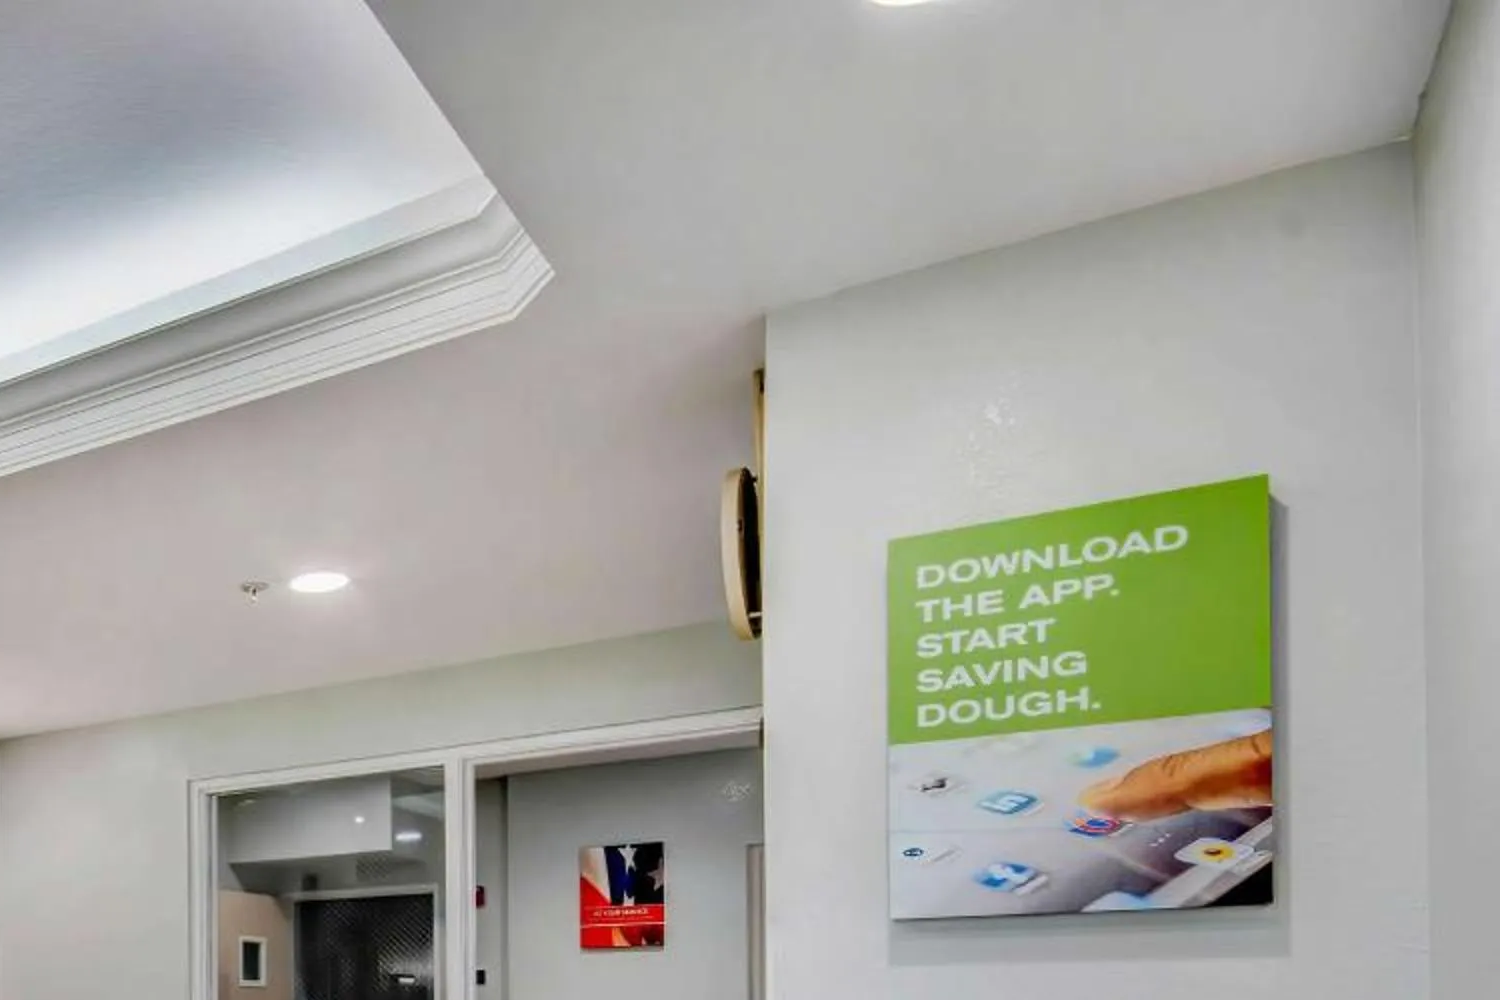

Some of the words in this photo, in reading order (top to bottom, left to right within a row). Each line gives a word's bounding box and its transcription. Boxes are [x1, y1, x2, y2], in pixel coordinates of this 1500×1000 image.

[916, 524, 1189, 589] DOWNLOAD
[916, 588, 1004, 623] THE
[1019, 573, 1120, 609] APP.
[916, 618, 1056, 658] START
[916, 650, 1088, 693] SAVING
[916, 686, 1101, 728] DOUGH.
